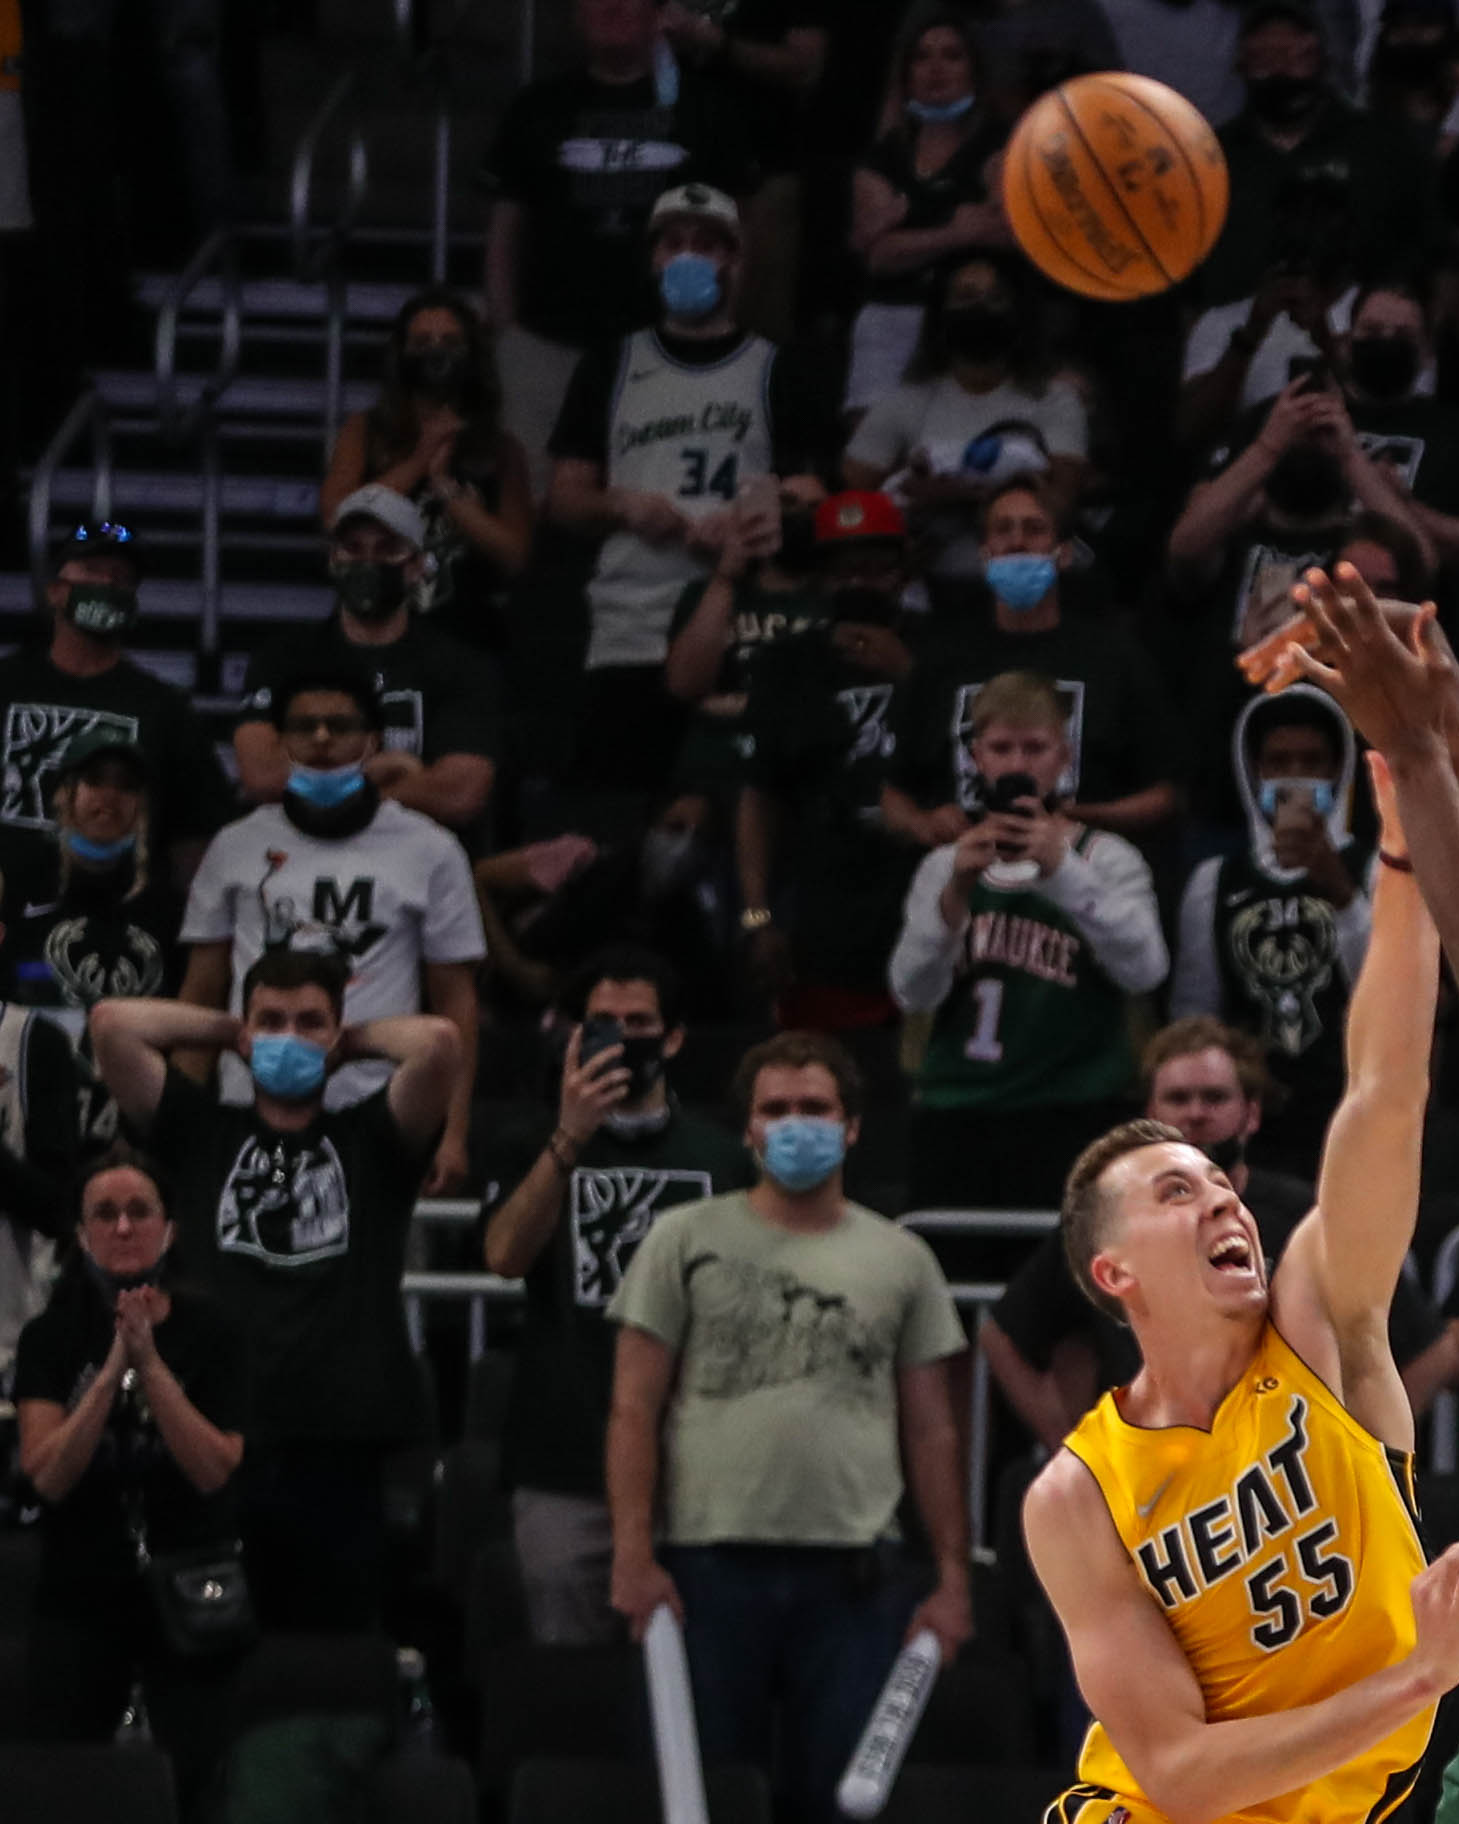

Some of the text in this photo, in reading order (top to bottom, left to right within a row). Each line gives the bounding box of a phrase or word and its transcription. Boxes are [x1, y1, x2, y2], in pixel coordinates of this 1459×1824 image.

[680, 448, 737, 500] 34
[313, 876, 374, 927] M
[965, 977, 1004, 1062] 1
[1135, 1393, 1320, 1609] HEAT
[1245, 1516, 1355, 1653] 55
